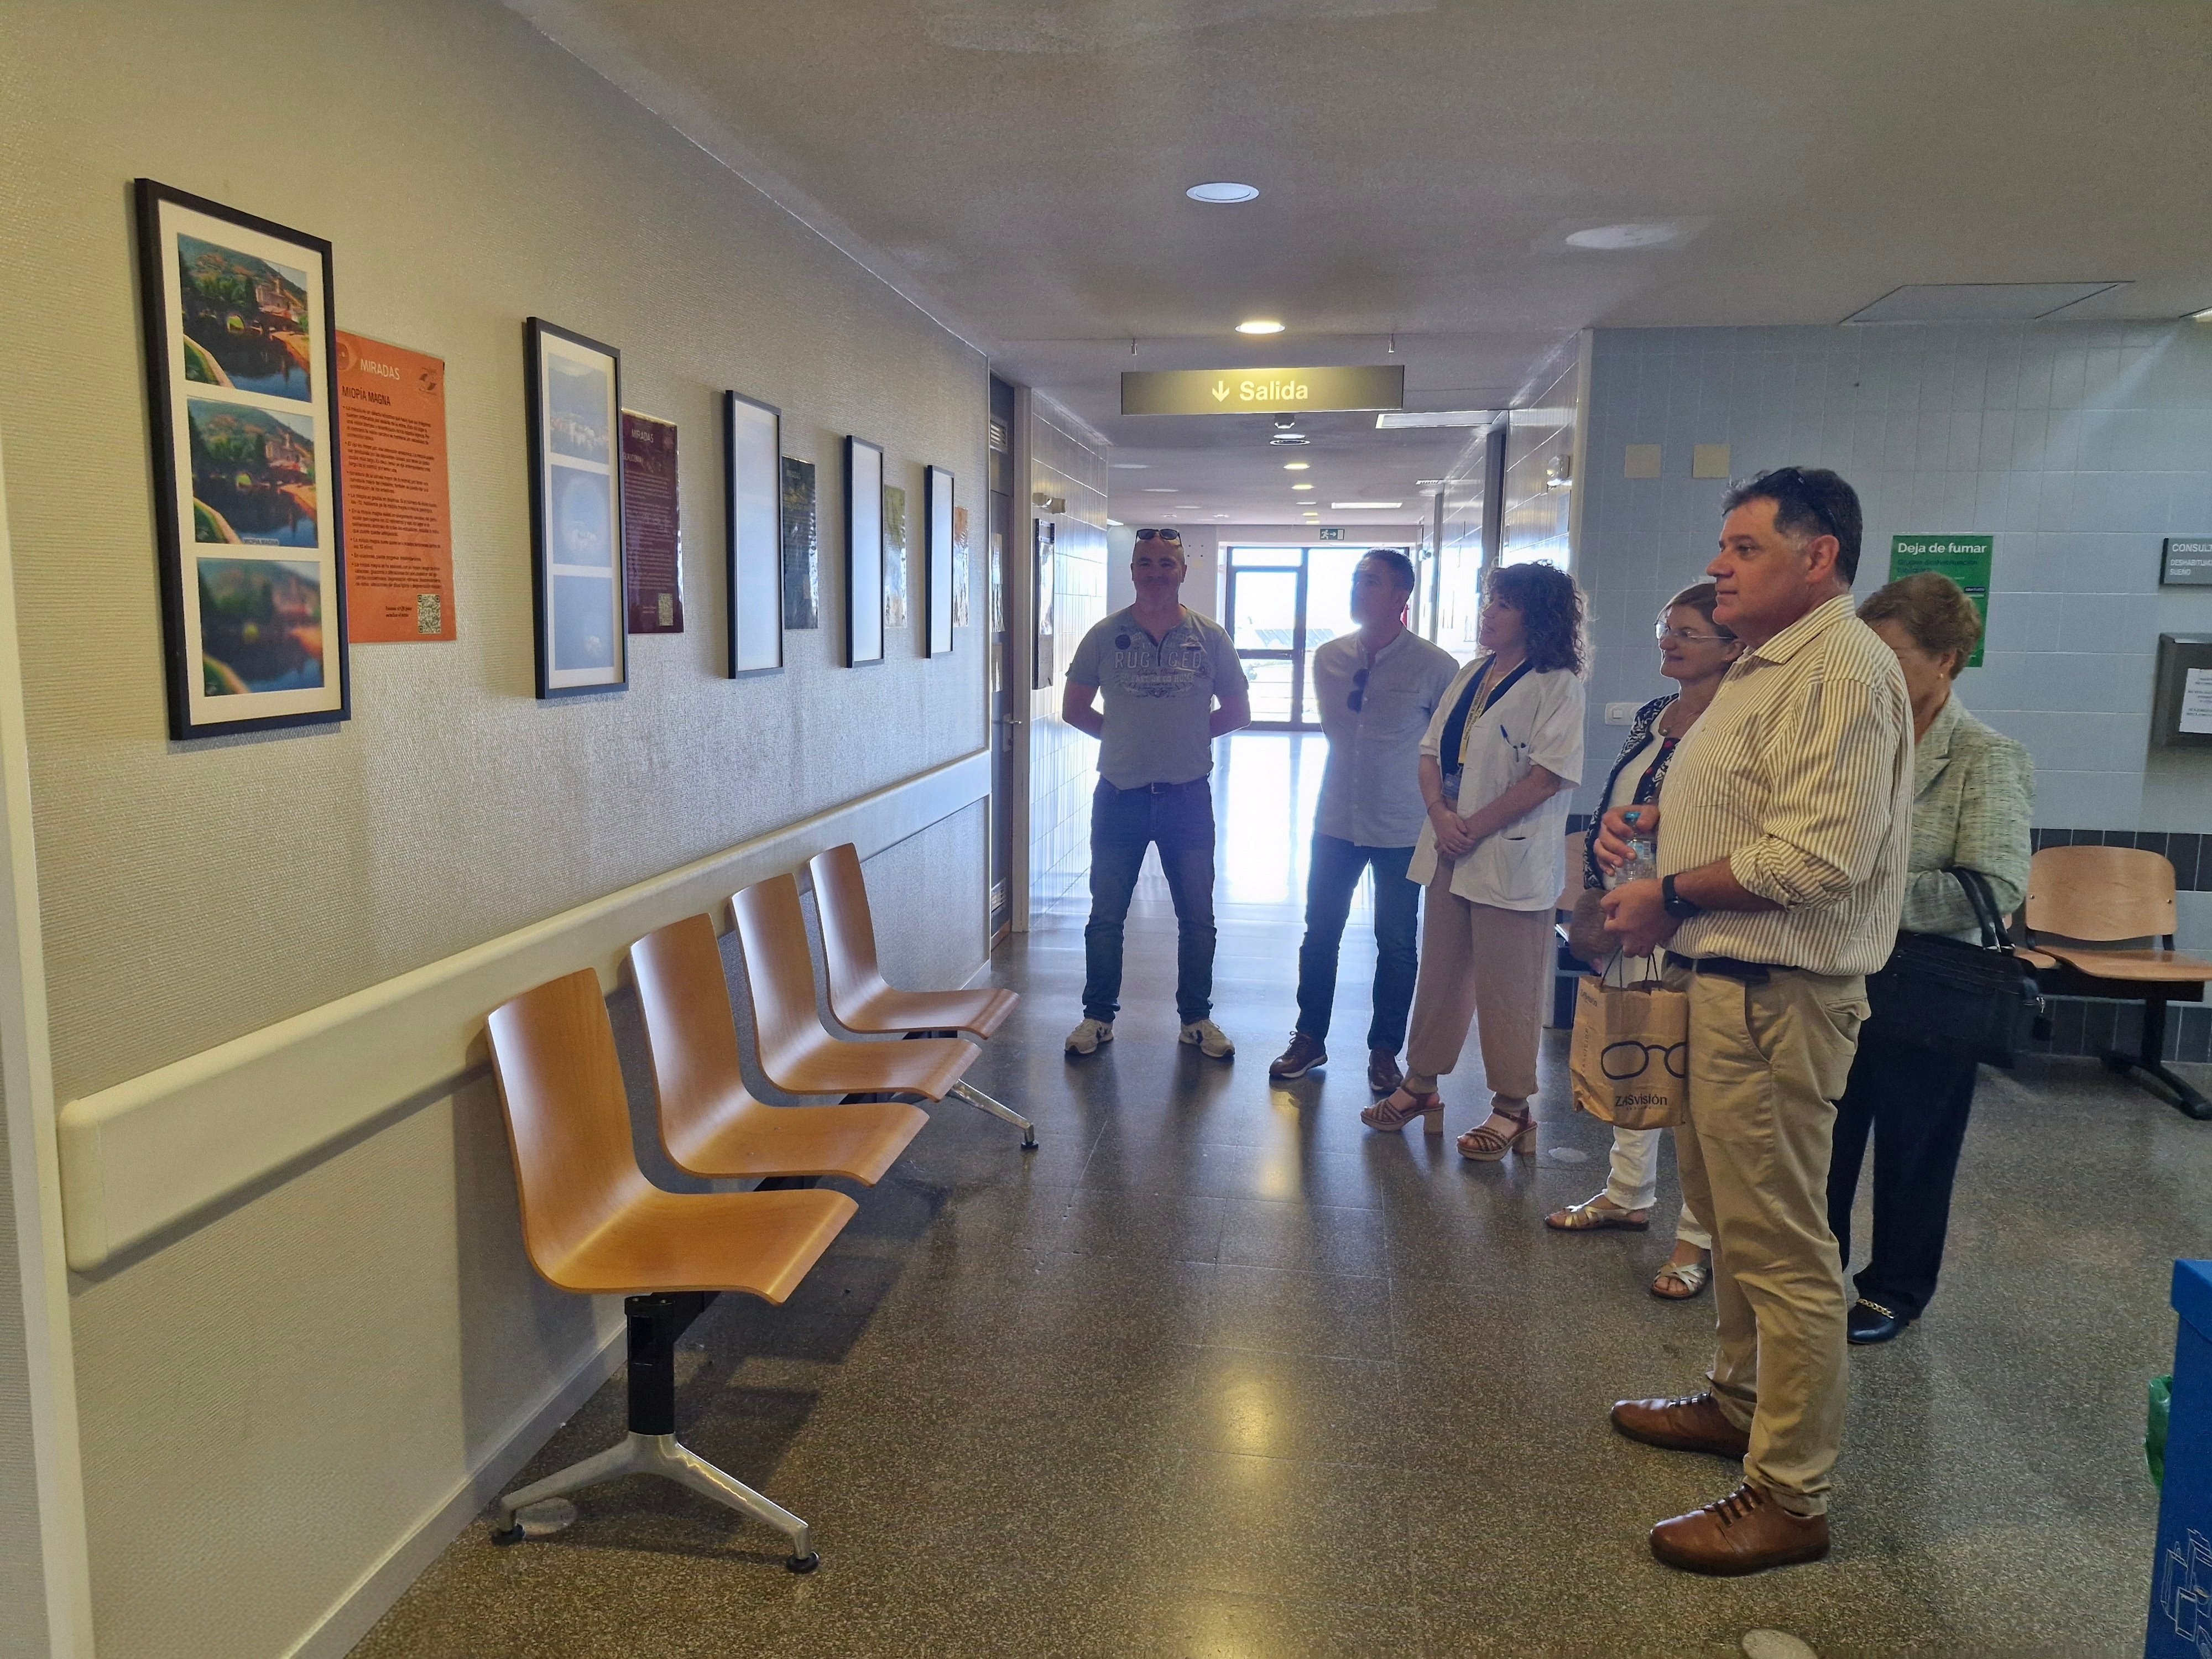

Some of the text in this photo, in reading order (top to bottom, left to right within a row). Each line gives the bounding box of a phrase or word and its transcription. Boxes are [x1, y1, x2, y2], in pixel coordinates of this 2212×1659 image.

[360, 358, 400, 380] MIRADAS
[342, 386, 391, 406] MIOPÍA MAGNA
[1239, 380, 1308, 401] Salida
[632, 429, 654, 443] MIRADAS
[1898, 542, 1987, 555] Deja de fumar
